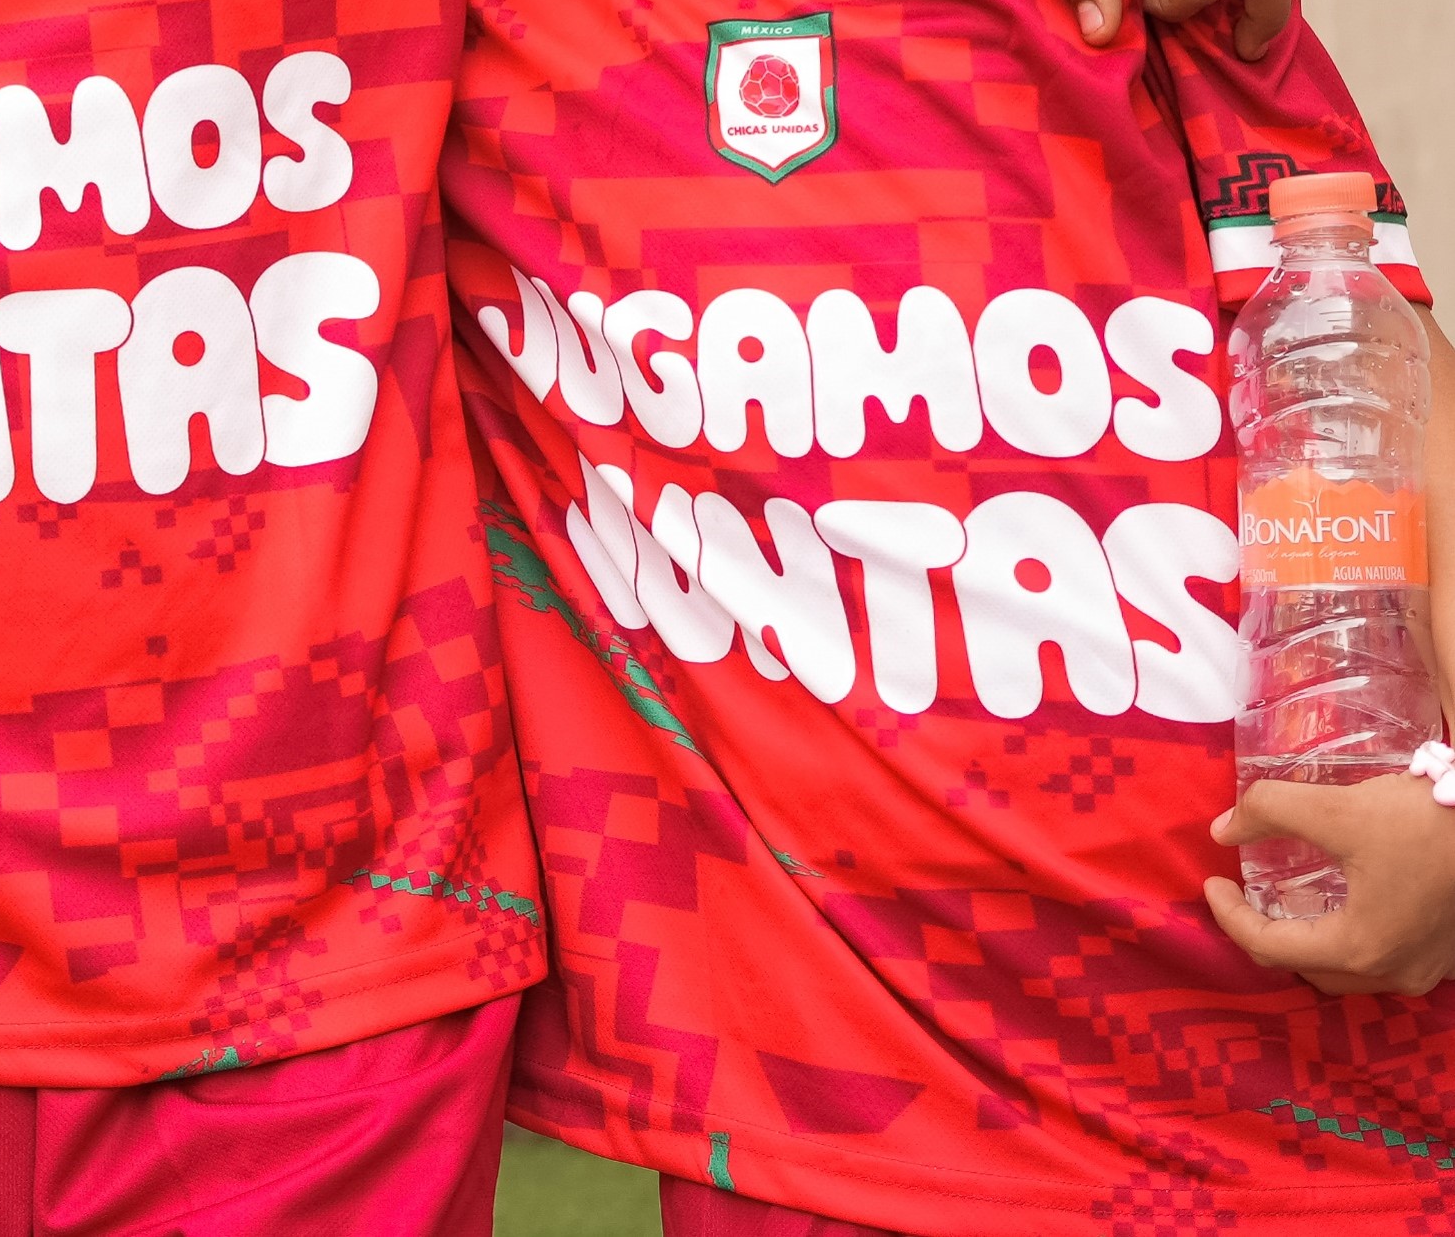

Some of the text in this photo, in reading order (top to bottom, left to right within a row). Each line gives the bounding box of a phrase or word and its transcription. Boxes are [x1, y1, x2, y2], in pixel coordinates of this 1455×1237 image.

[741, 25, 793, 36] MÉXICO
[727, 124, 819, 136] CHICAS UNIDAS
[478, 265, 1222, 461] JUGAMOS
[1242, 509, 1396, 547] BONAFONT
[1333, 566, 1407, 581] AGUA NATURAL
